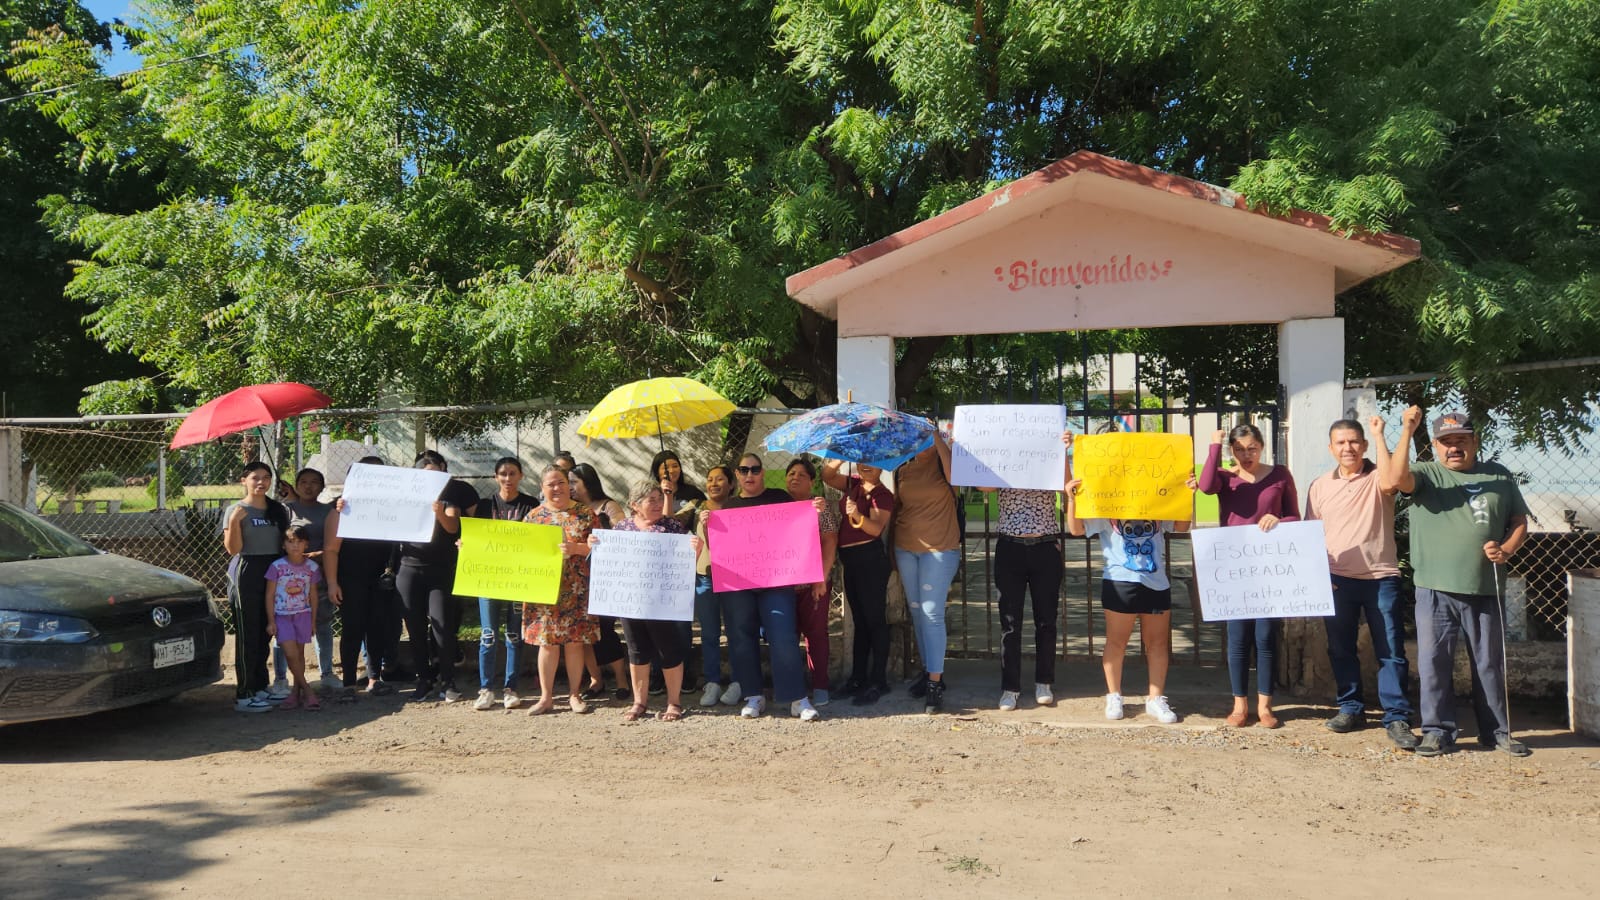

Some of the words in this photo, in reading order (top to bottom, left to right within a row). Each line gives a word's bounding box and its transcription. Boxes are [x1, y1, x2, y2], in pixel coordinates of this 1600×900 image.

[1008, 255, 1160, 291] Bienvenidos
[969, 428, 991, 438] sin
[1002, 427, 1060, 440] respuesta
[1080, 442, 1176, 461] ESCUELA
[1084, 463, 1177, 480] CERRADA
[1156, 483, 1176, 496] los
[485, 540, 524, 553] APOYO
[633, 544, 668, 557] cerrada
[1213, 541, 1298, 560] ESCUELA
[462, 559, 514, 576] QUEREMOS
[594, 558, 619, 568] tener
[623, 560, 640, 568] una
[647, 559, 690, 571] respuesta
[1214, 564, 1296, 583] CERRADA
[594, 588, 608, 602] NO
[613, 590, 656, 606] CLASES
[660, 593, 677, 607] EN
[1206, 588, 1232, 604] Por
[1243, 584, 1282, 602] falta
[1293, 583, 1308, 596] de
